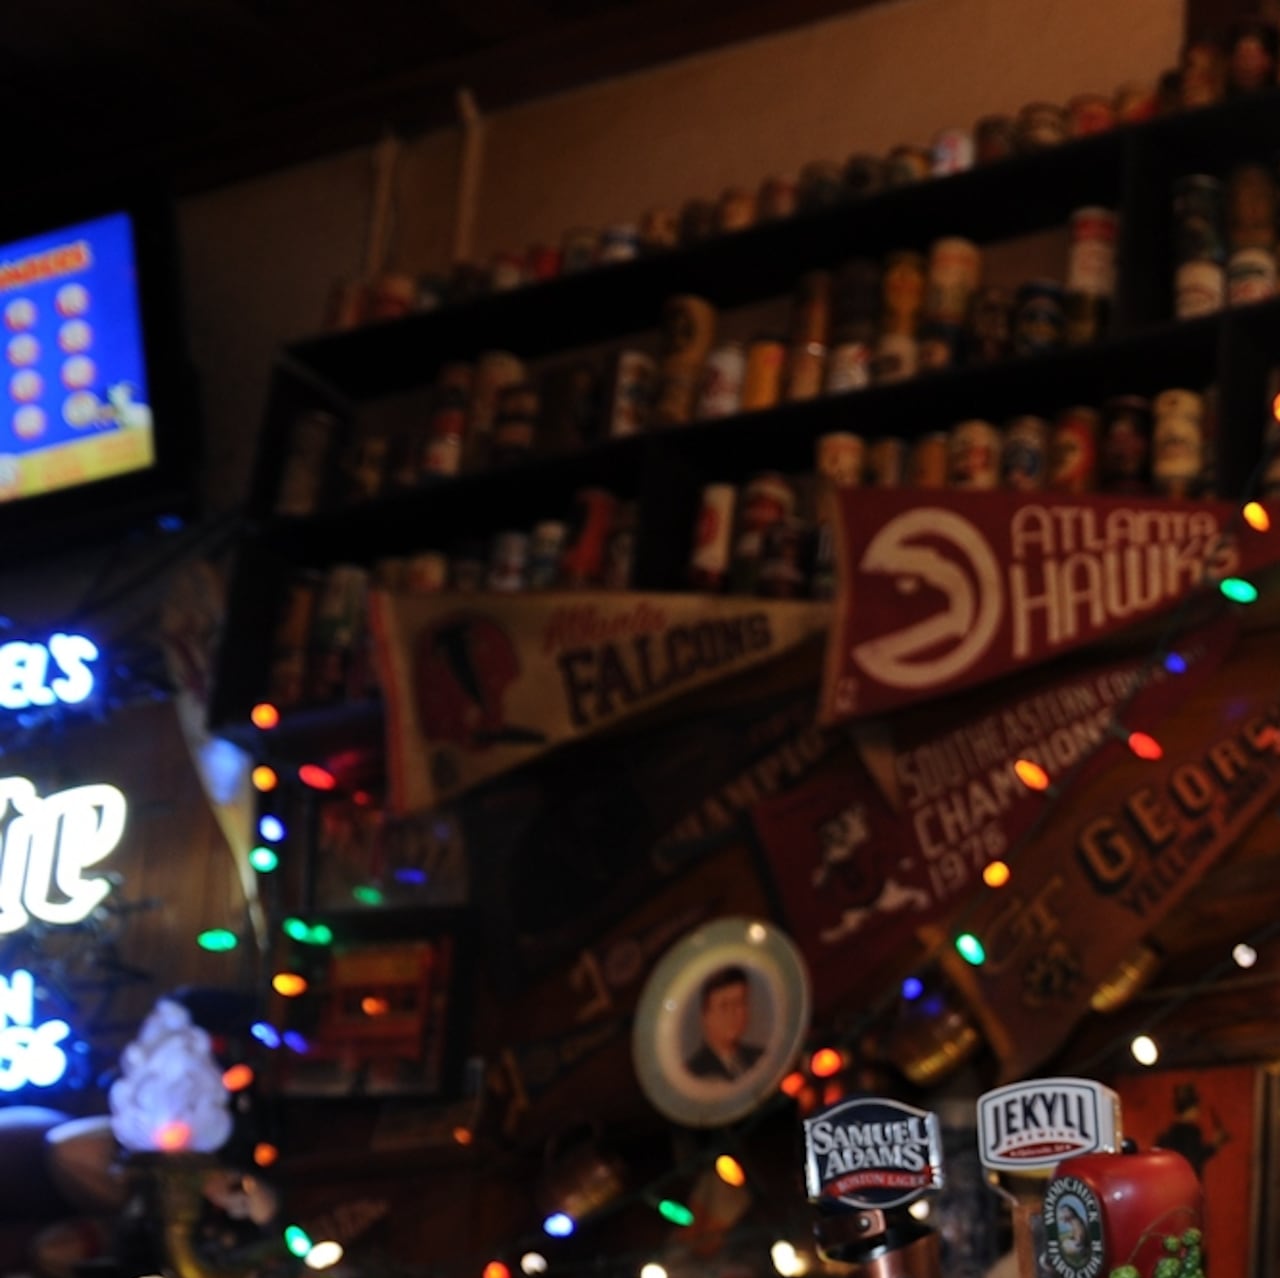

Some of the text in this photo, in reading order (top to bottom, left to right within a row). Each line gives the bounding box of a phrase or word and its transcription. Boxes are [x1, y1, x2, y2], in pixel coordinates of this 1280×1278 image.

[1010, 502, 1220, 558] ATLANTA
[1008, 532, 1240, 660] HAWKS
[557, 612, 773, 727] FALCONS
[811, 1116, 929, 1155] SAMUEL
[991, 1092, 1092, 1151] JEKYLL
[823, 1143, 925, 1181] ADAMS
[1044, 1176, 1099, 1226] WOODCHUCK
